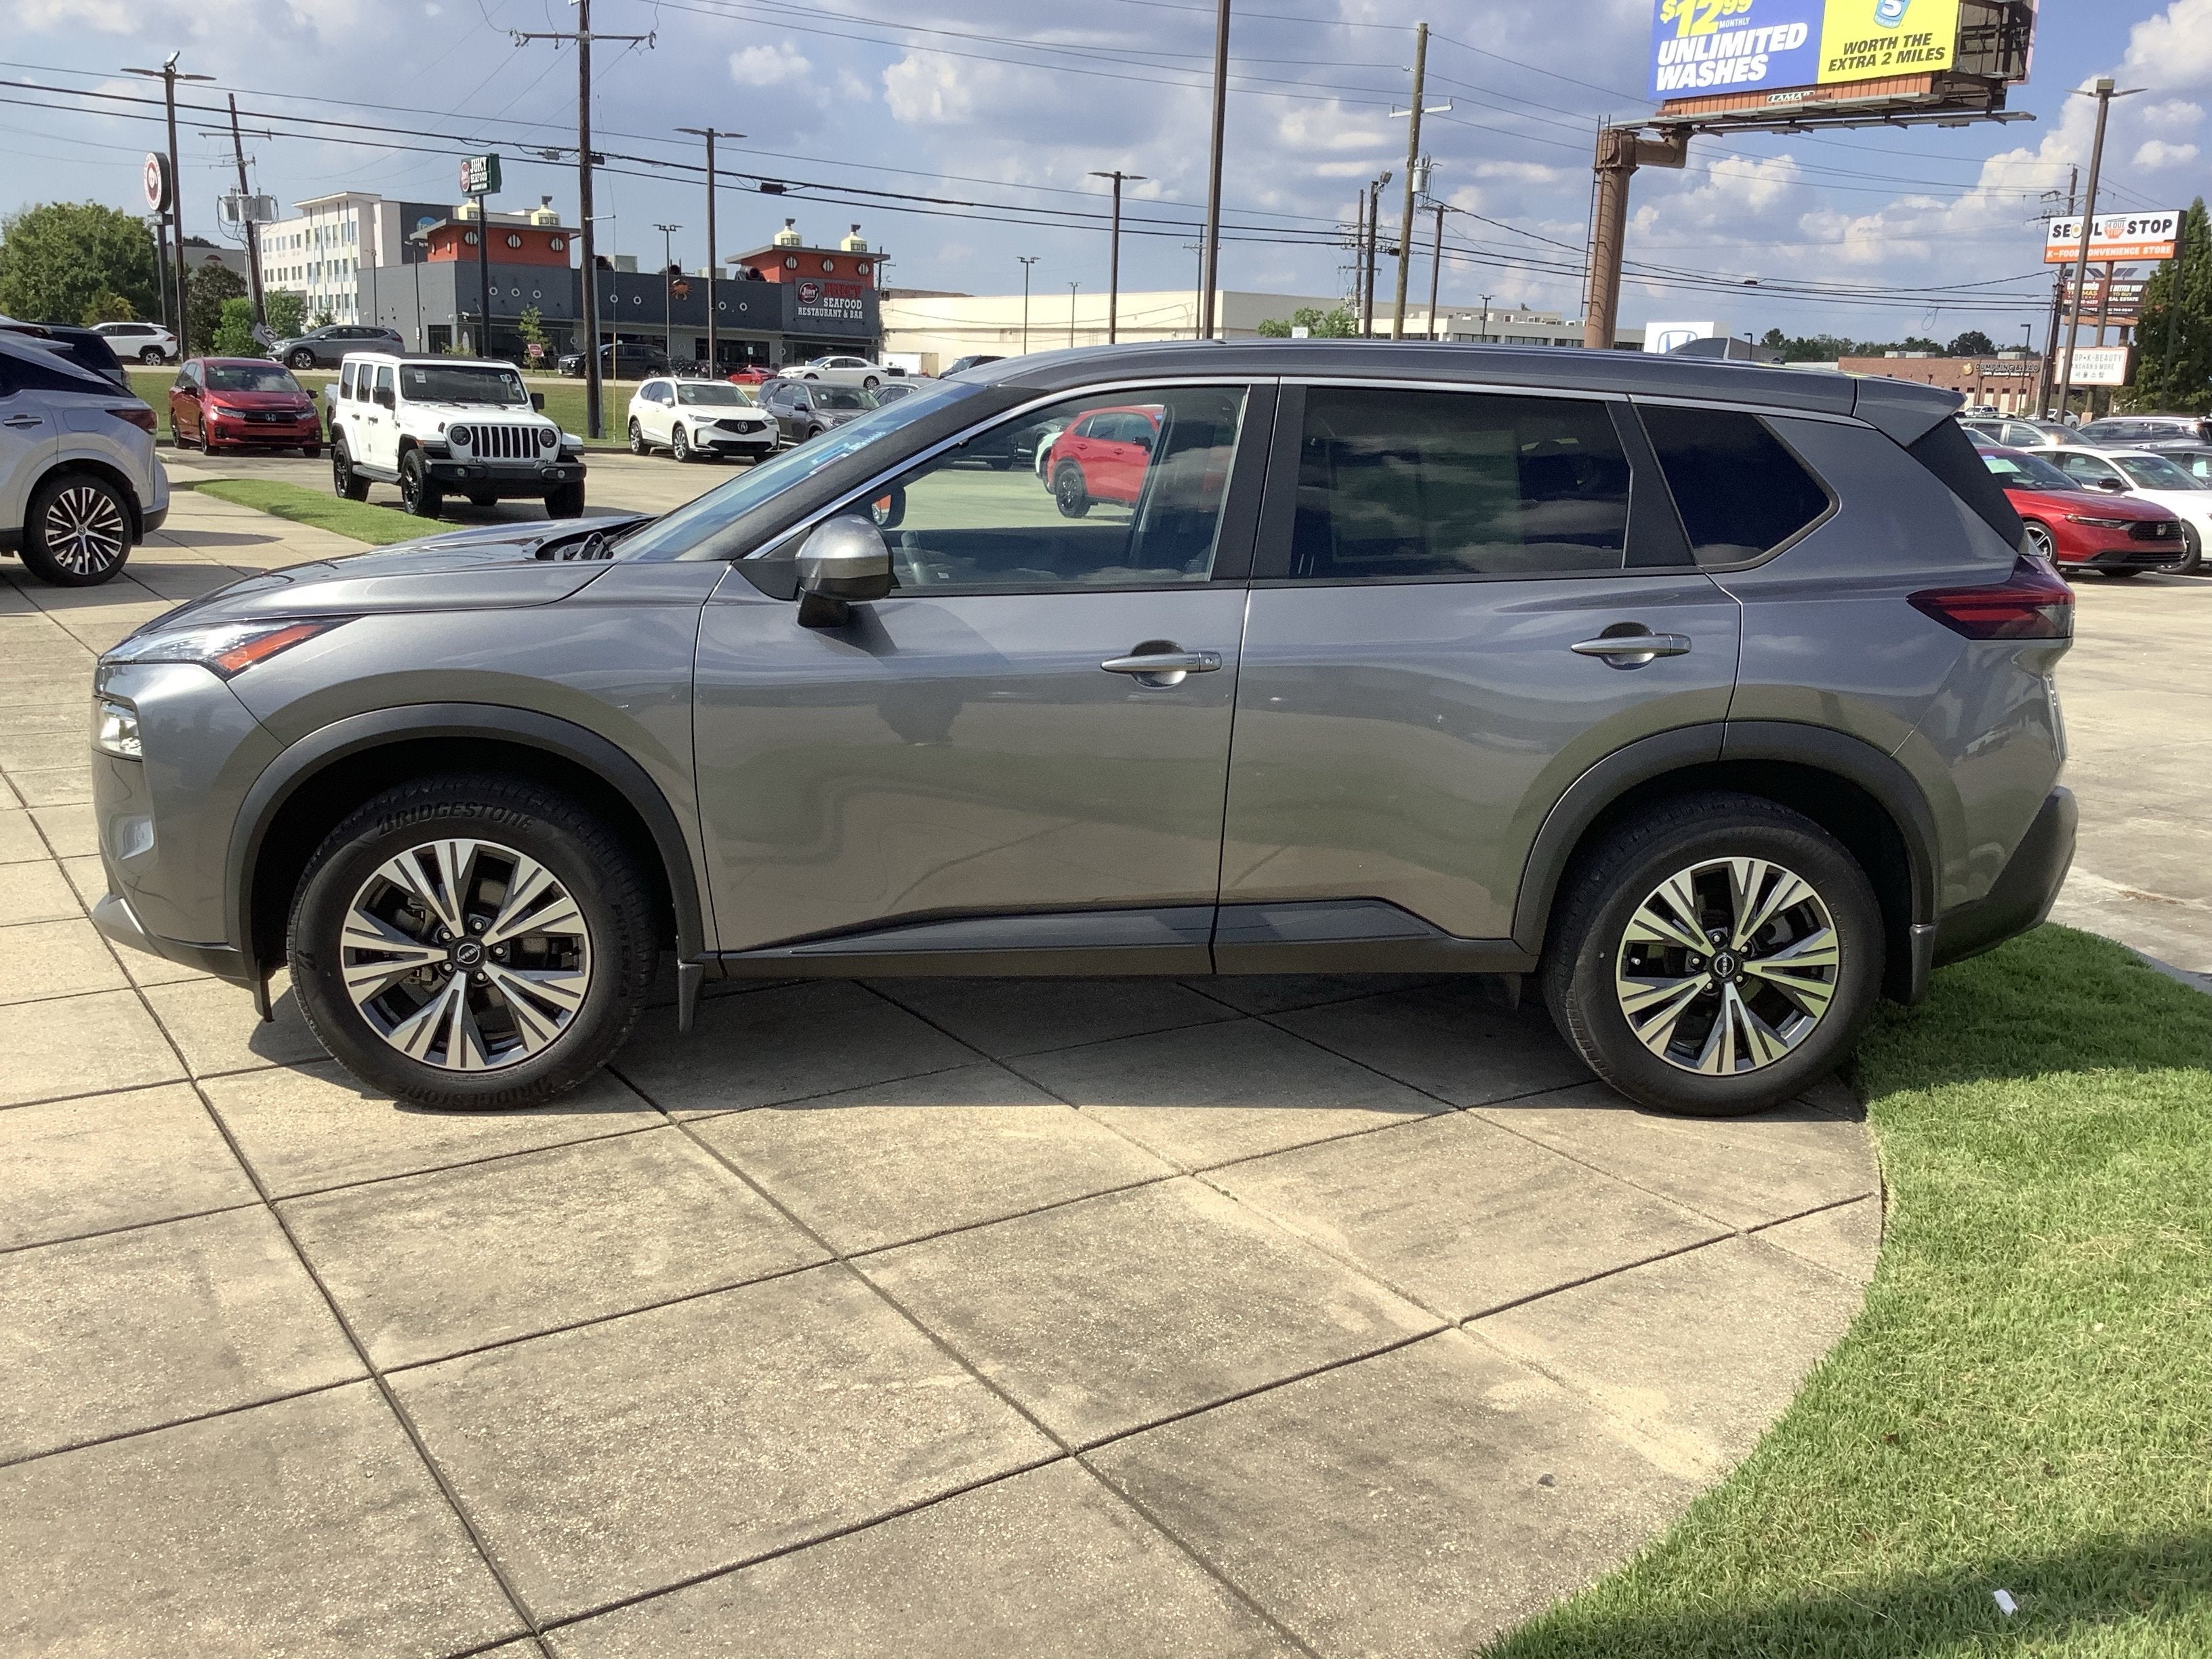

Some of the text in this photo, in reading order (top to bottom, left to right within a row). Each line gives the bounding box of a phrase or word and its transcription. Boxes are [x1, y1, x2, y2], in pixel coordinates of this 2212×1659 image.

[1719, 17, 1750, 29] MONTHLY
[1658, 22, 1808, 65] UNLIMITED
[1843, 33, 1933, 55] WORTH THE
[1828, 47, 1946, 72] EXTRA 2 MILES
[1656, 54, 1769, 91] WASHES
[470, 157, 487, 173] JUICY
[2127, 219, 2173, 234] STOP
[2087, 246, 2140, 256] ONVENIENCE
[2143, 245, 2171, 255] STORE
[821, 283, 862, 298] JUICY
[823, 298, 863, 309] SEAFOOD
[798, 307, 863, 319] RESTAURANT & BAR
[2087, 354, 2123, 362] K-BEAUTY
[1975, 363, 2015, 372] DUMPLING
[376, 801, 537, 836] BRIDGESTONE
